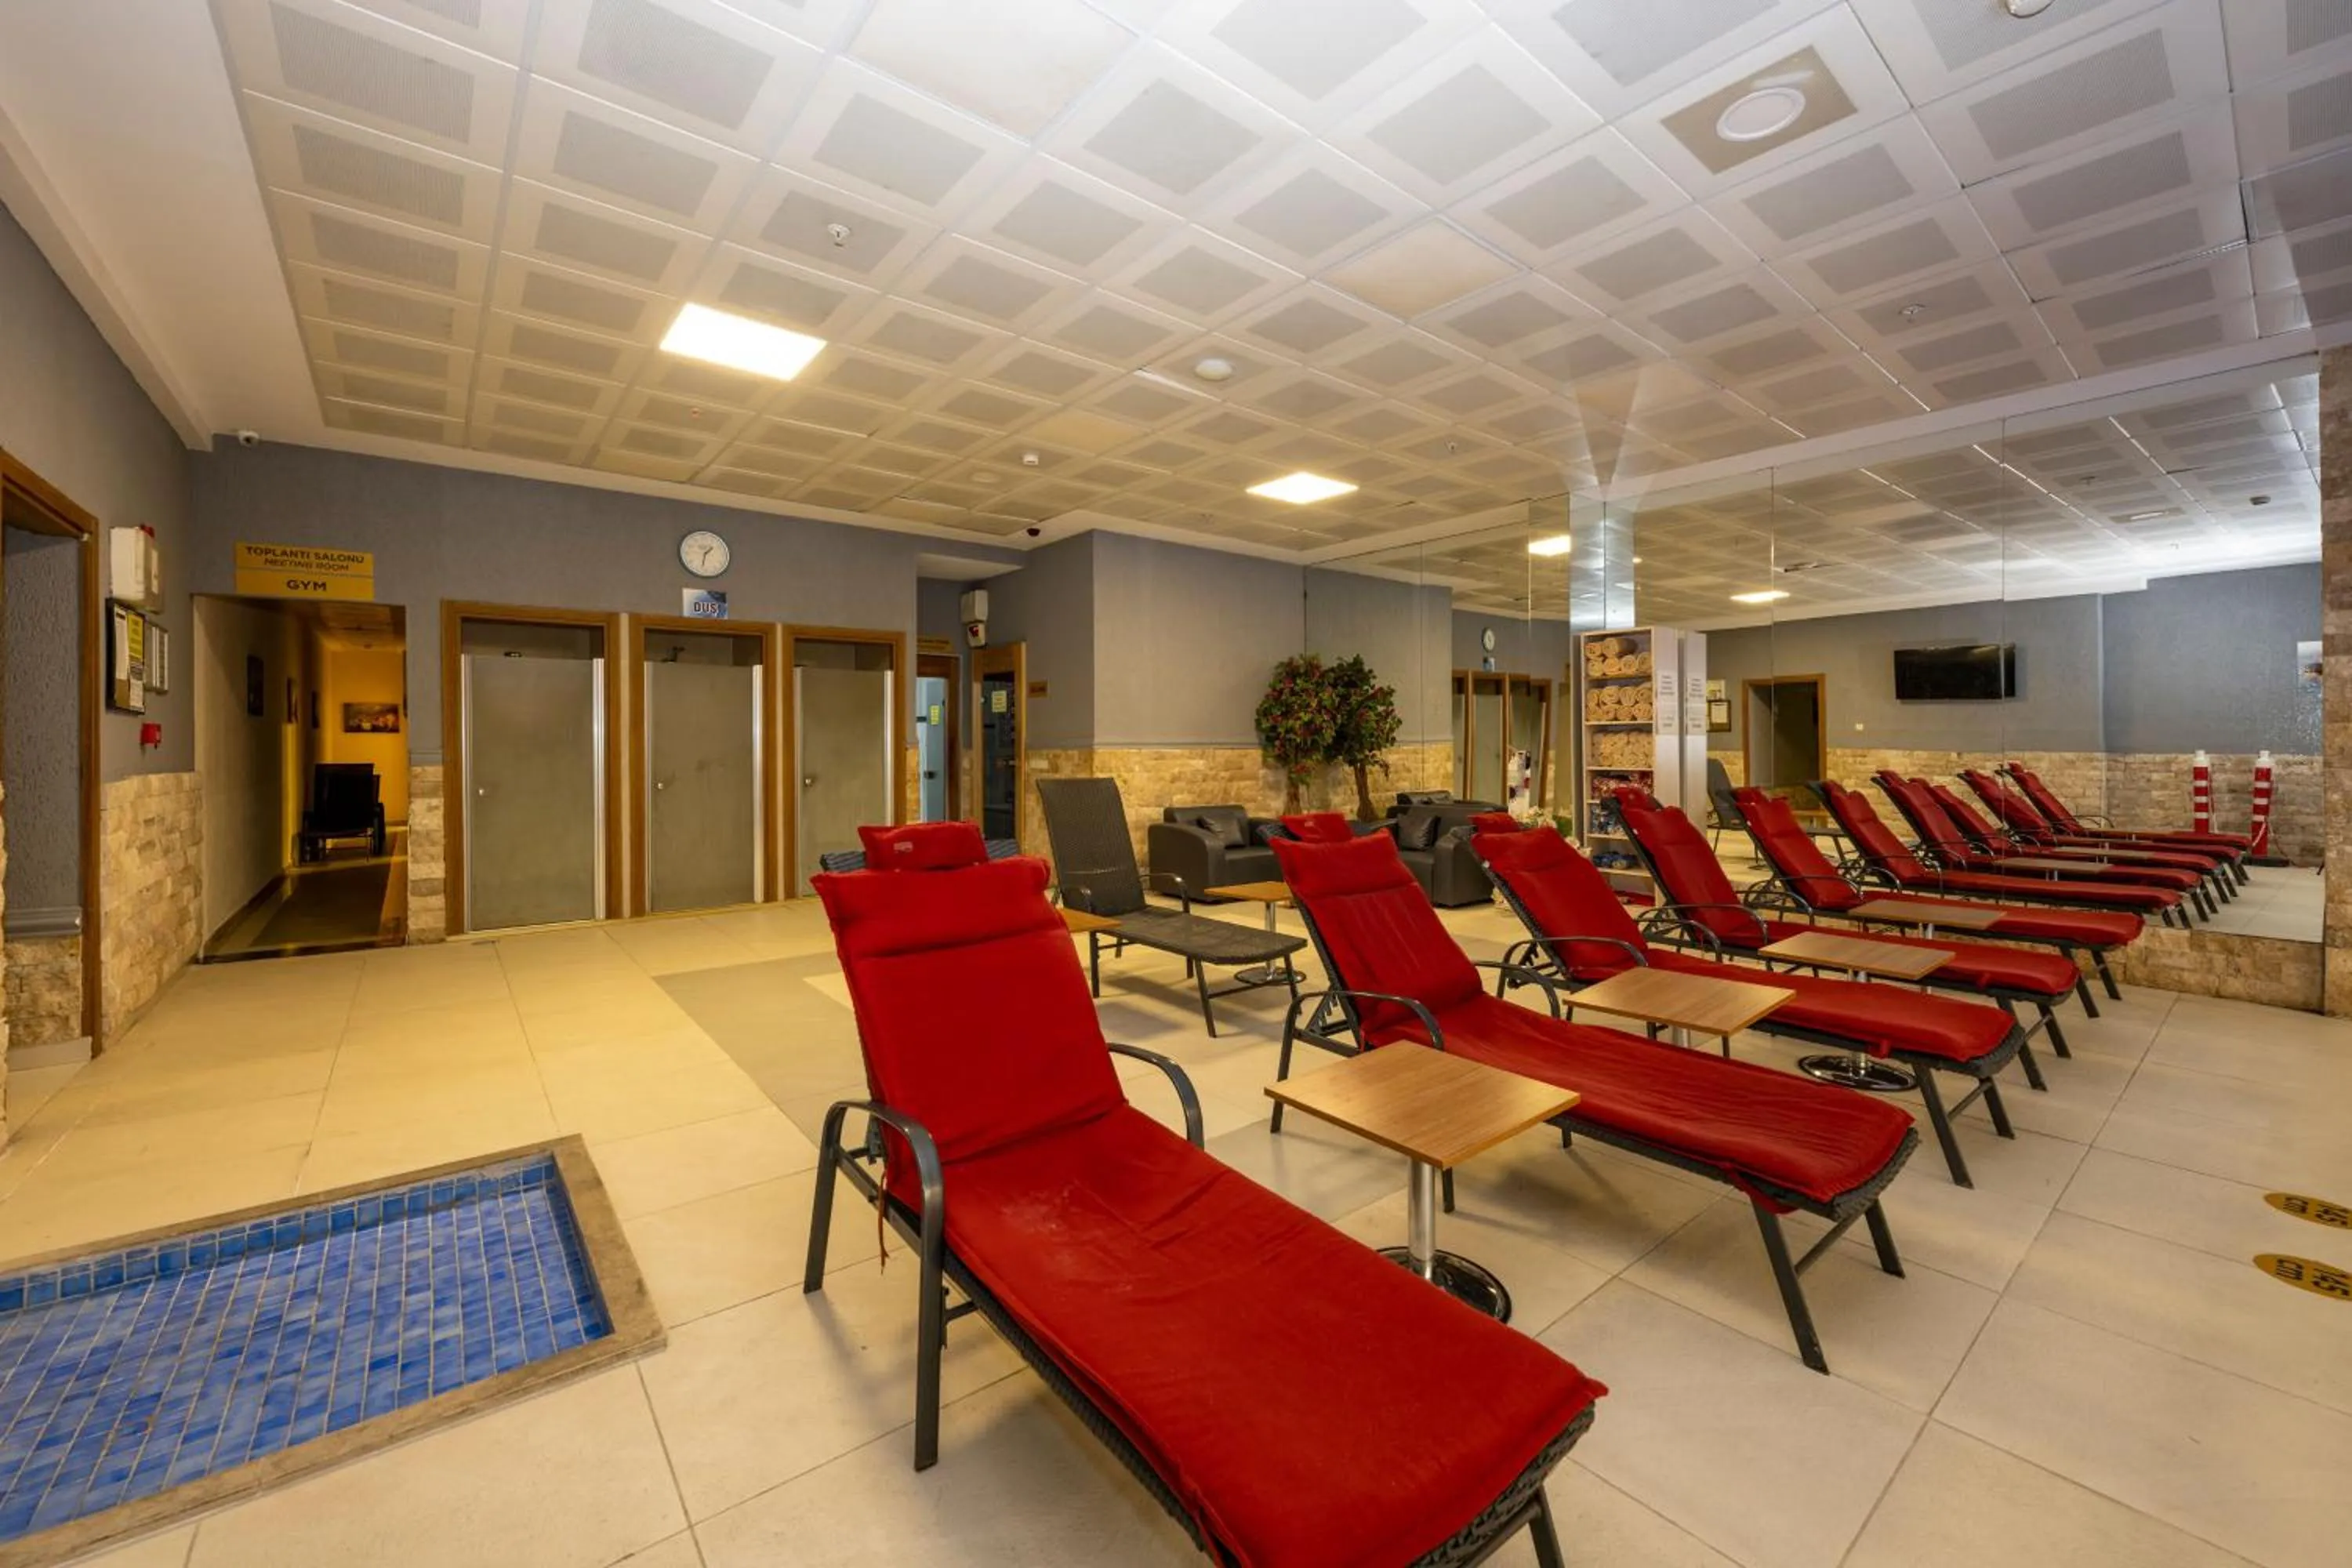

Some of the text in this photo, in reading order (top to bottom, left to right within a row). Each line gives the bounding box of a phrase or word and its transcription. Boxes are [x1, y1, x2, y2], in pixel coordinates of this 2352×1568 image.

[245, 546, 365, 564] TOPLANTI SALONU
[316, 562, 350, 572] ROOM
[286, 579, 327, 591] GYM
